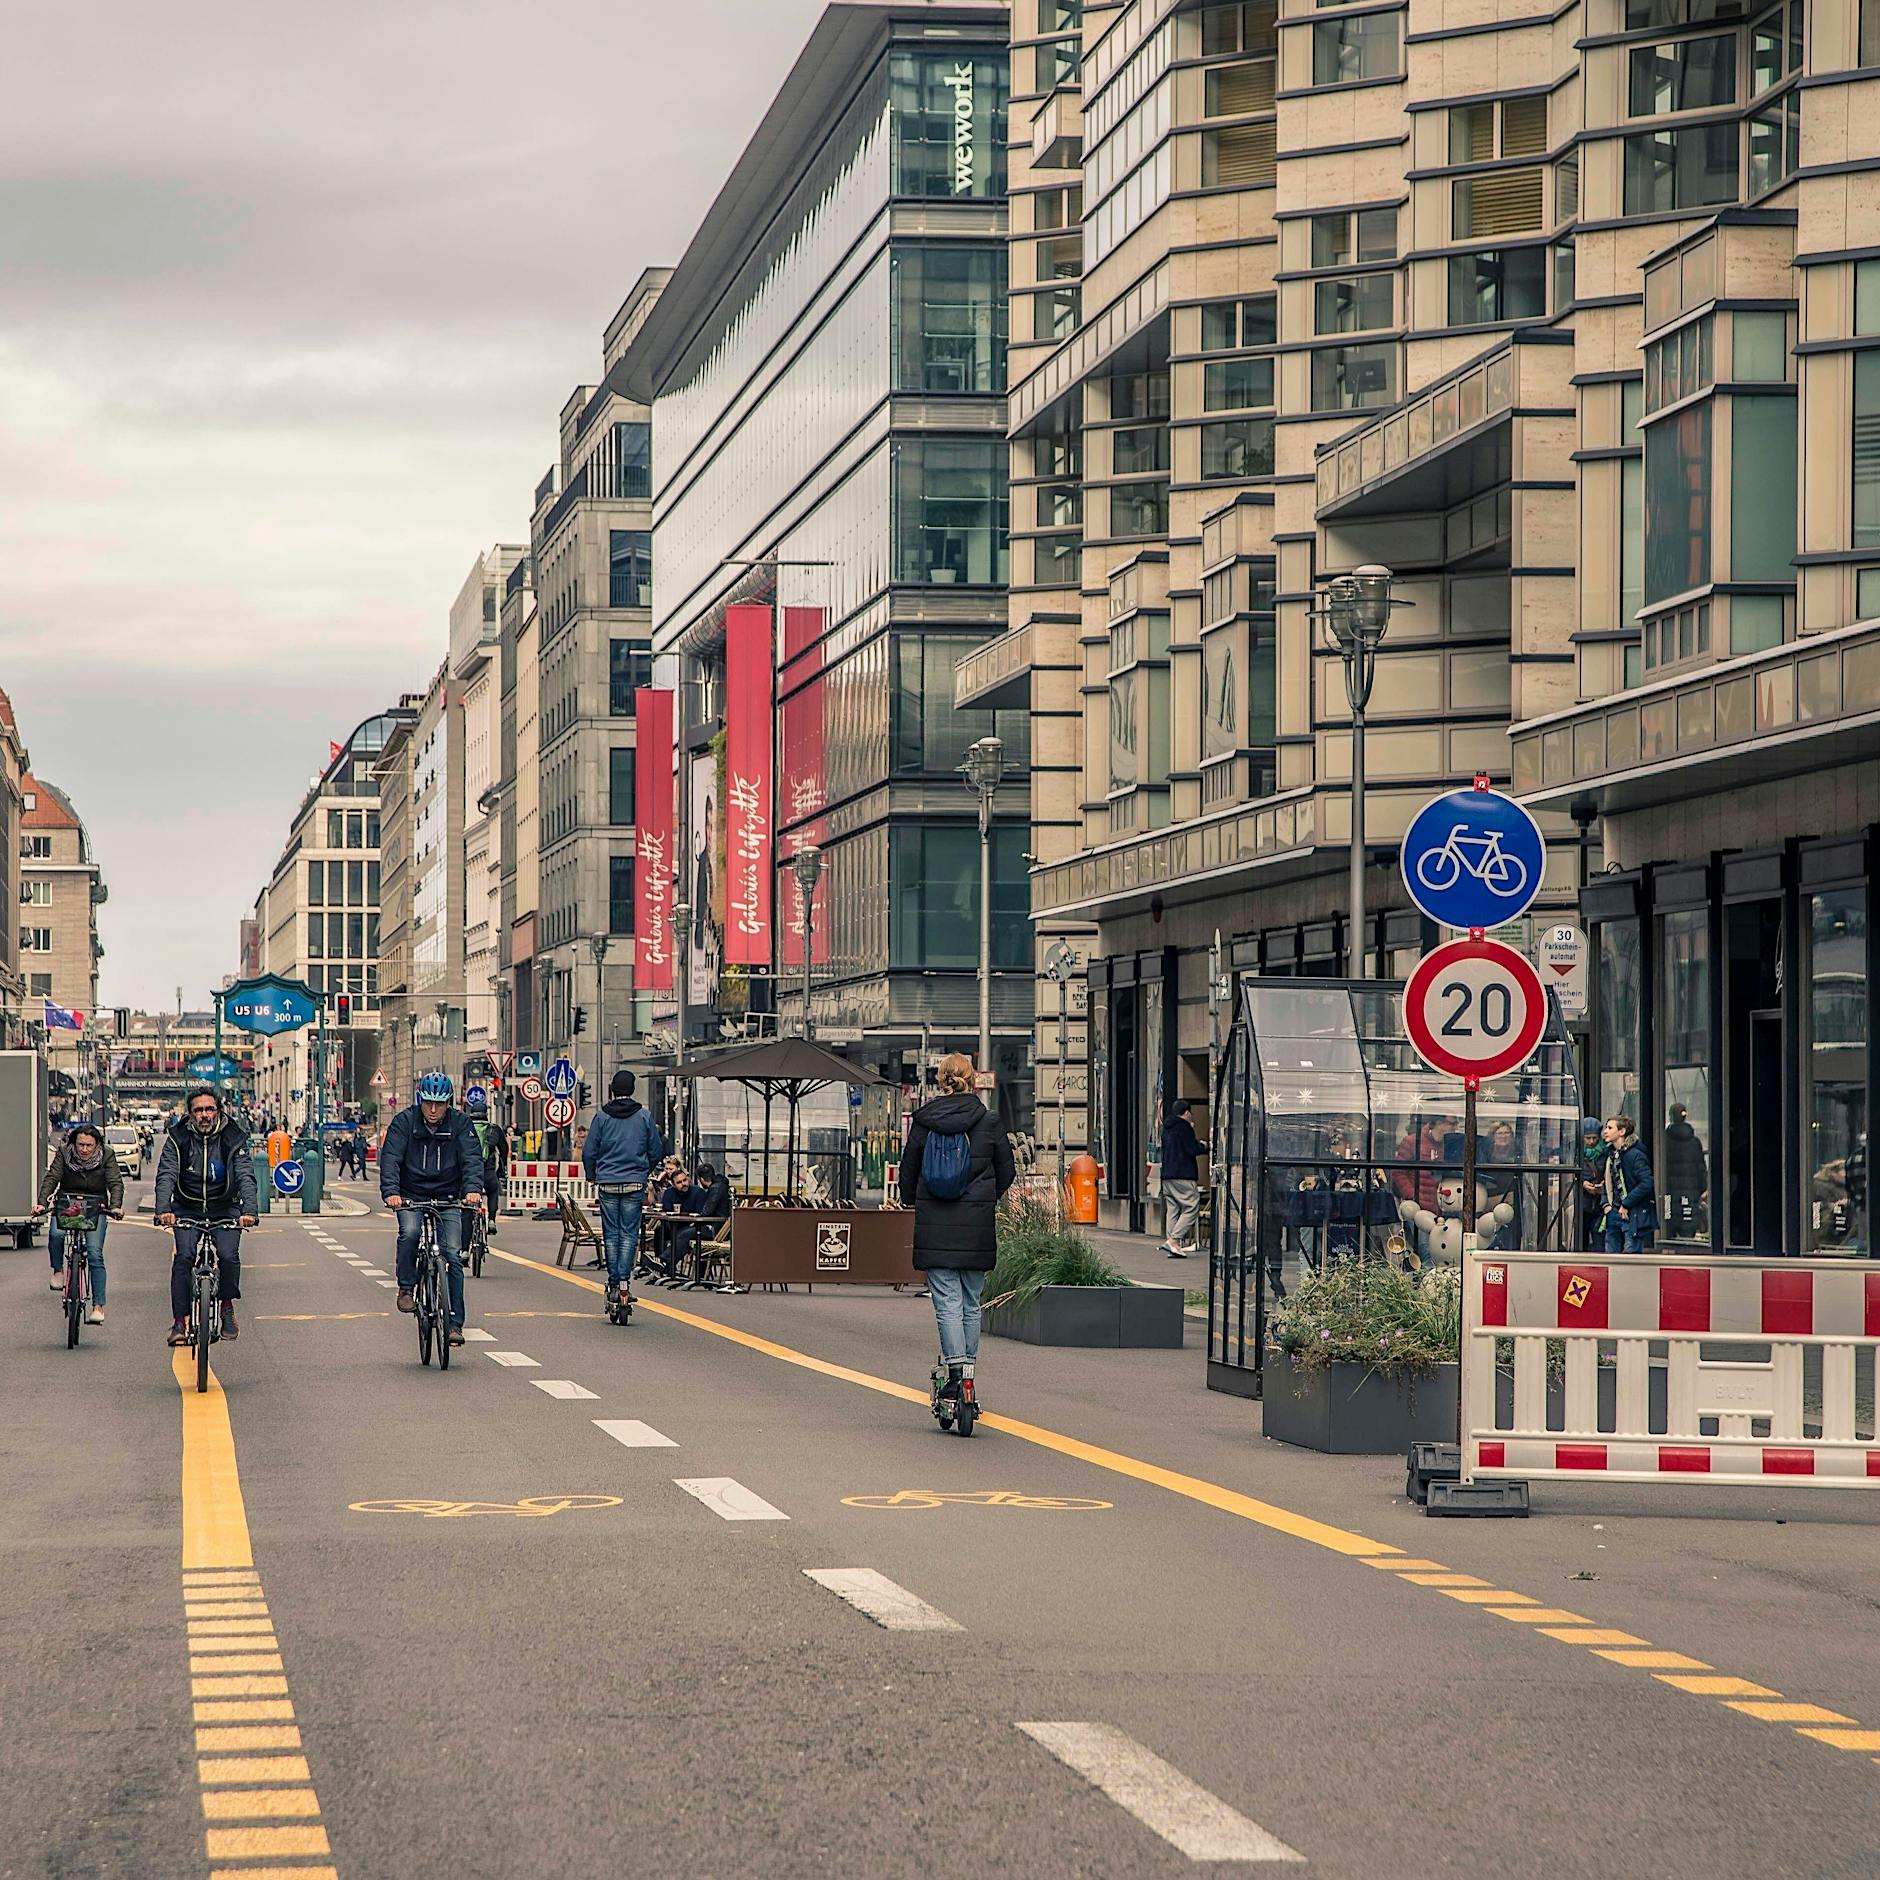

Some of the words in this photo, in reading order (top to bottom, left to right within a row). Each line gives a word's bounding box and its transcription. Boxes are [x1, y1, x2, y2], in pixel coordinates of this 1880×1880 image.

[943, 61, 974, 194] wework
[1557, 930, 1572, 941] 30
[1544, 942, 1582, 951] Parkschein-
[1550, 953, 1576, 961] automat
[1557, 988, 1583, 997] schein
[235, 1006, 251, 1015] U5
[254, 1006, 270, 1015] U6
[1441, 982, 1512, 1038] 20
[274, 1013, 291, 1022] 300
[115, 1080, 146, 1088] BAHNHOF
[527, 1084, 538, 1094] 50
[552, 1104, 568, 1116] 20
